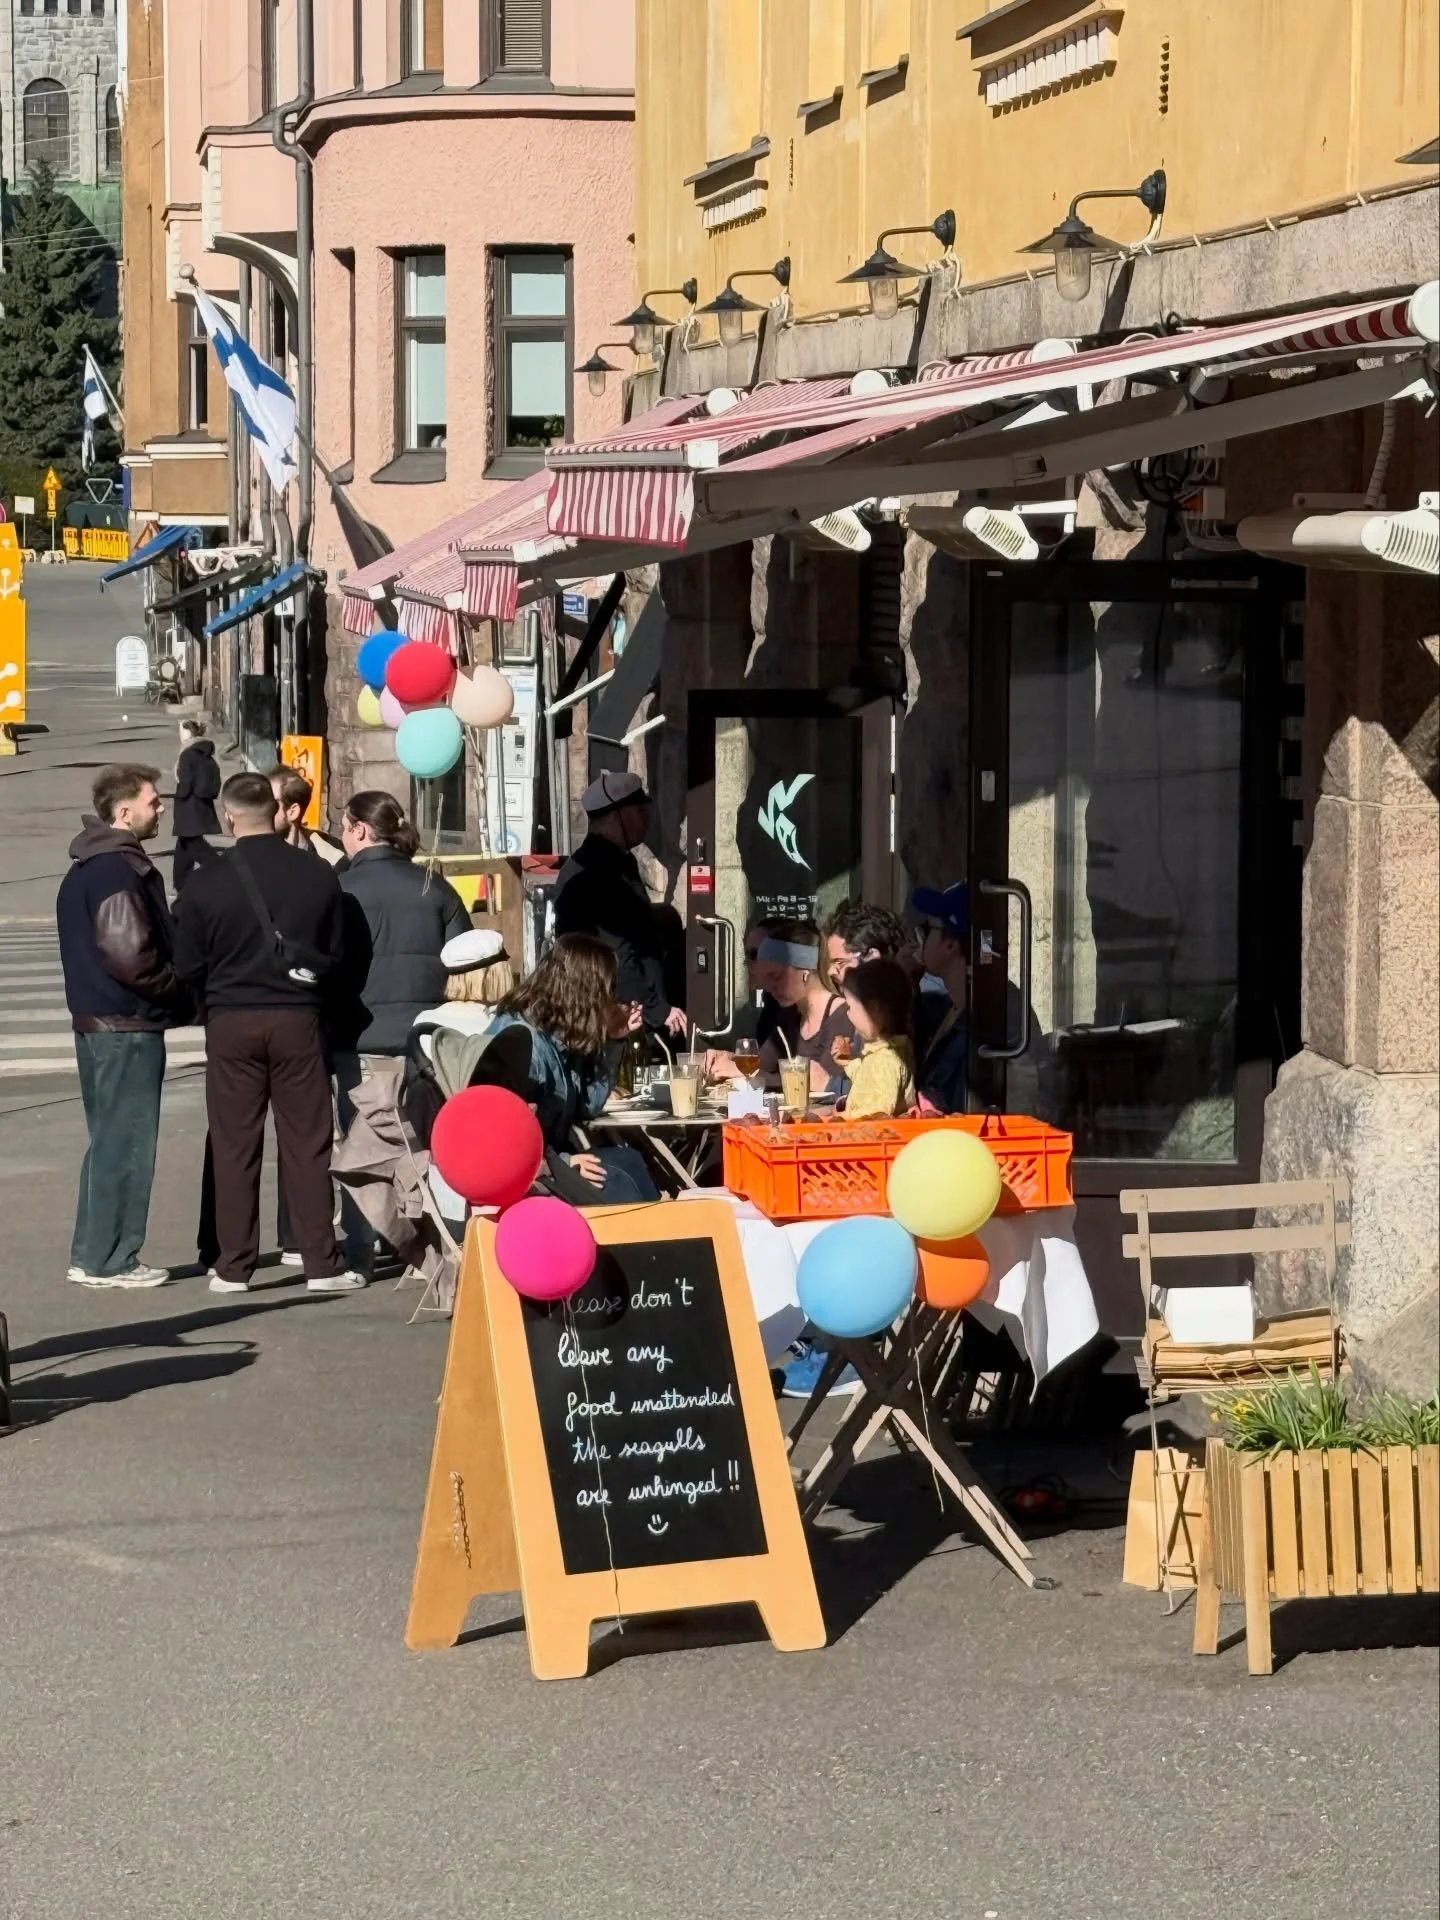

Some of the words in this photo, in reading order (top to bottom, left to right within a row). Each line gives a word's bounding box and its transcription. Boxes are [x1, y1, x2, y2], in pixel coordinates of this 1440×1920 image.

[564, 1295, 622, 1314] ease
[631, 1278, 694, 1309] don't
[558, 1331, 613, 1367] leave
[627, 1344, 673, 1372] any
[565, 1391, 622, 1432] food
[630, 1384, 735, 1415] unattended
[573, 1436, 611, 1464] the
[618, 1426, 706, 1463] seagulls
[576, 1486, 612, 1506] are
[628, 1468, 722, 1505] unhinged
